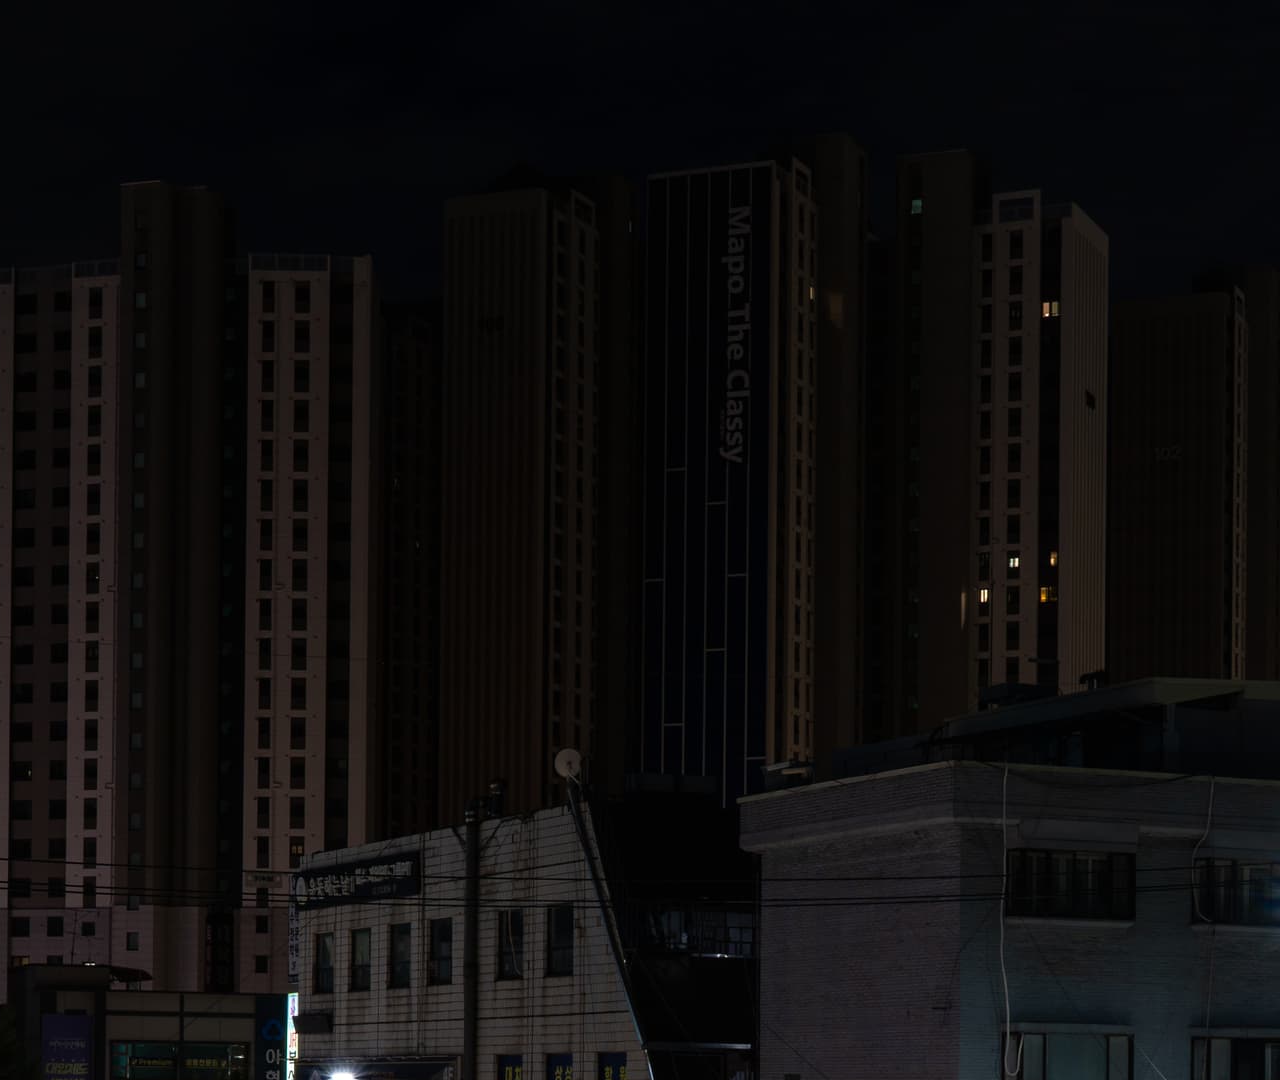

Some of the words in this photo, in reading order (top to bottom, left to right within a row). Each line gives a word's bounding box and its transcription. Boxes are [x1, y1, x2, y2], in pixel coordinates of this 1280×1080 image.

[720, 205, 751, 294] Mapo
[726, 303, 751, 363] The
[720, 367, 751, 465] Classy
